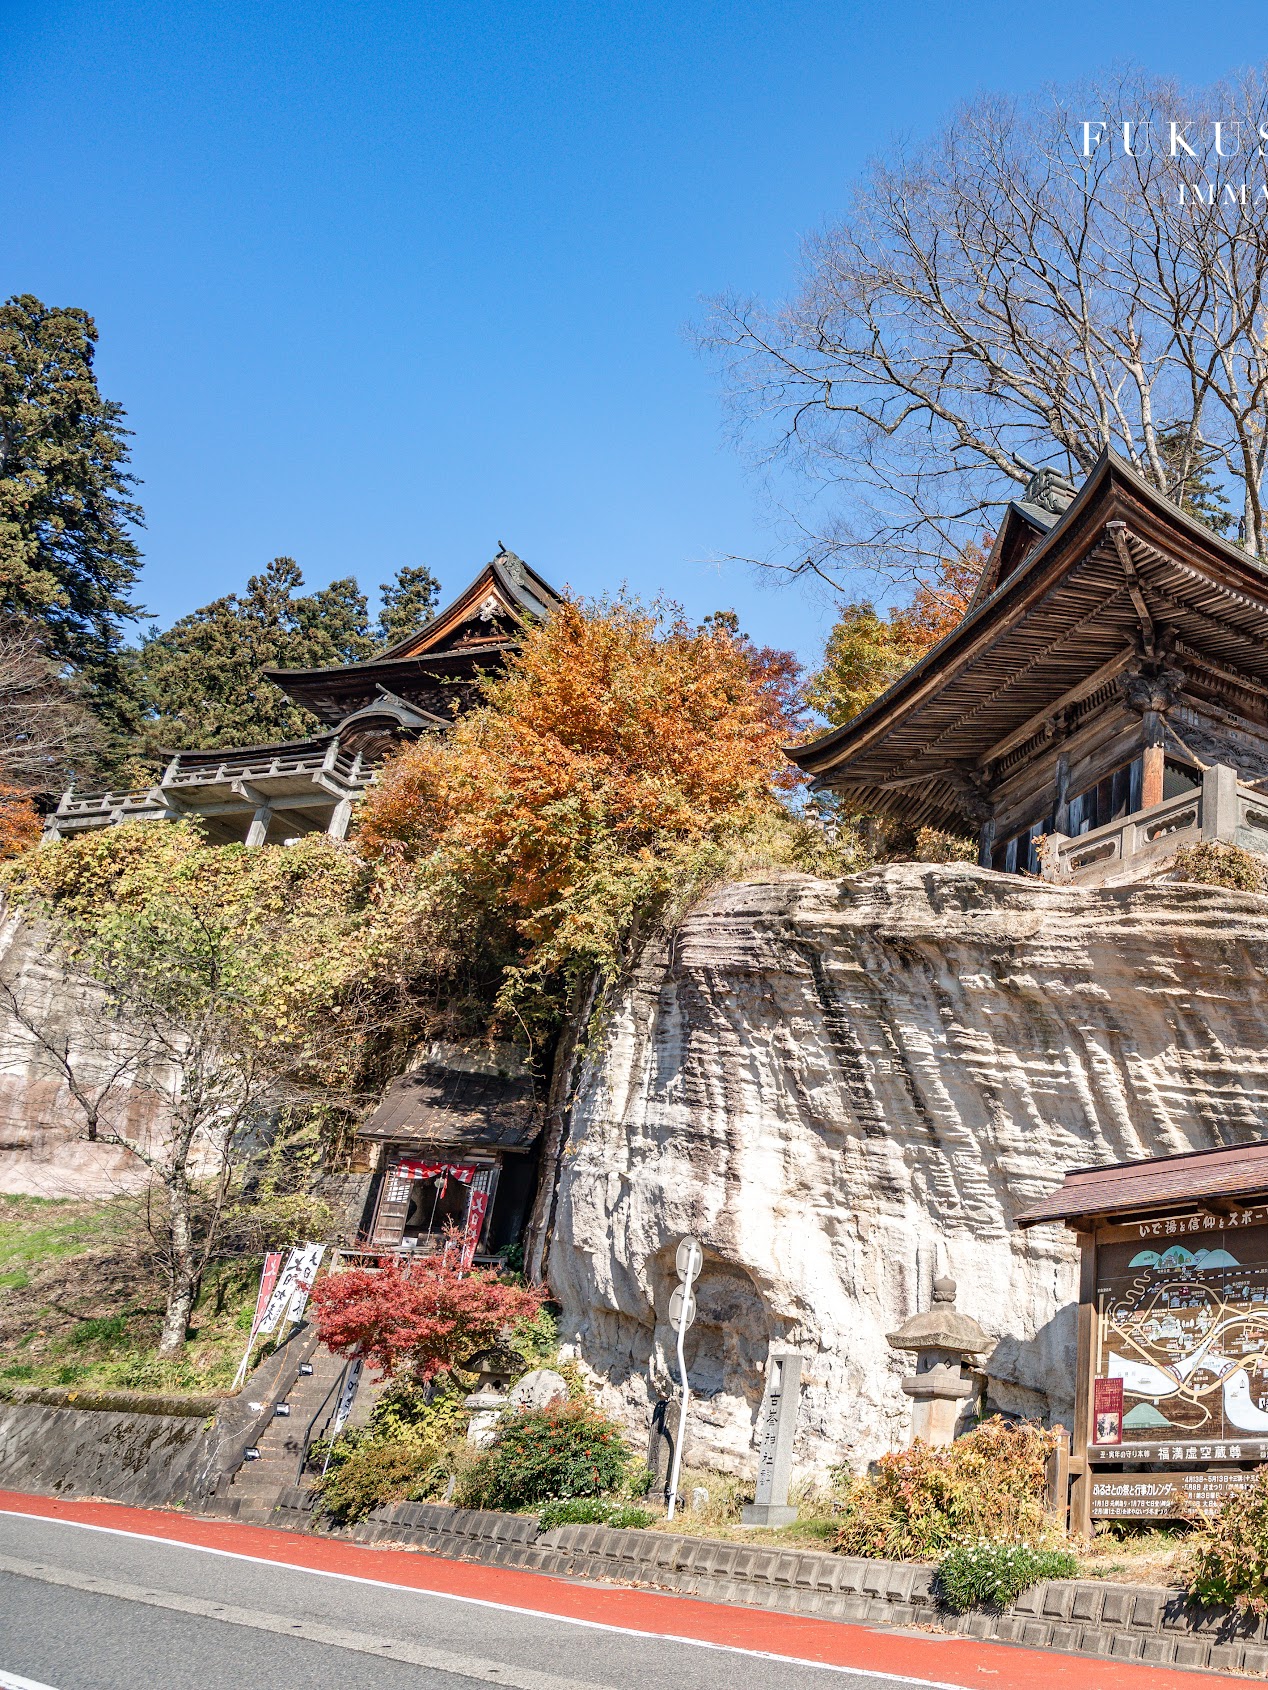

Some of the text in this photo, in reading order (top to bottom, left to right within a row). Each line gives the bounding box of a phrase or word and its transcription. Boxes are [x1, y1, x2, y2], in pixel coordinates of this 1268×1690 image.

[1157, 1445, 1243, 1461] 福満虚空蔵尊
[1092, 1482, 1178, 1496] ふるさとの祭と行事カレンダー
